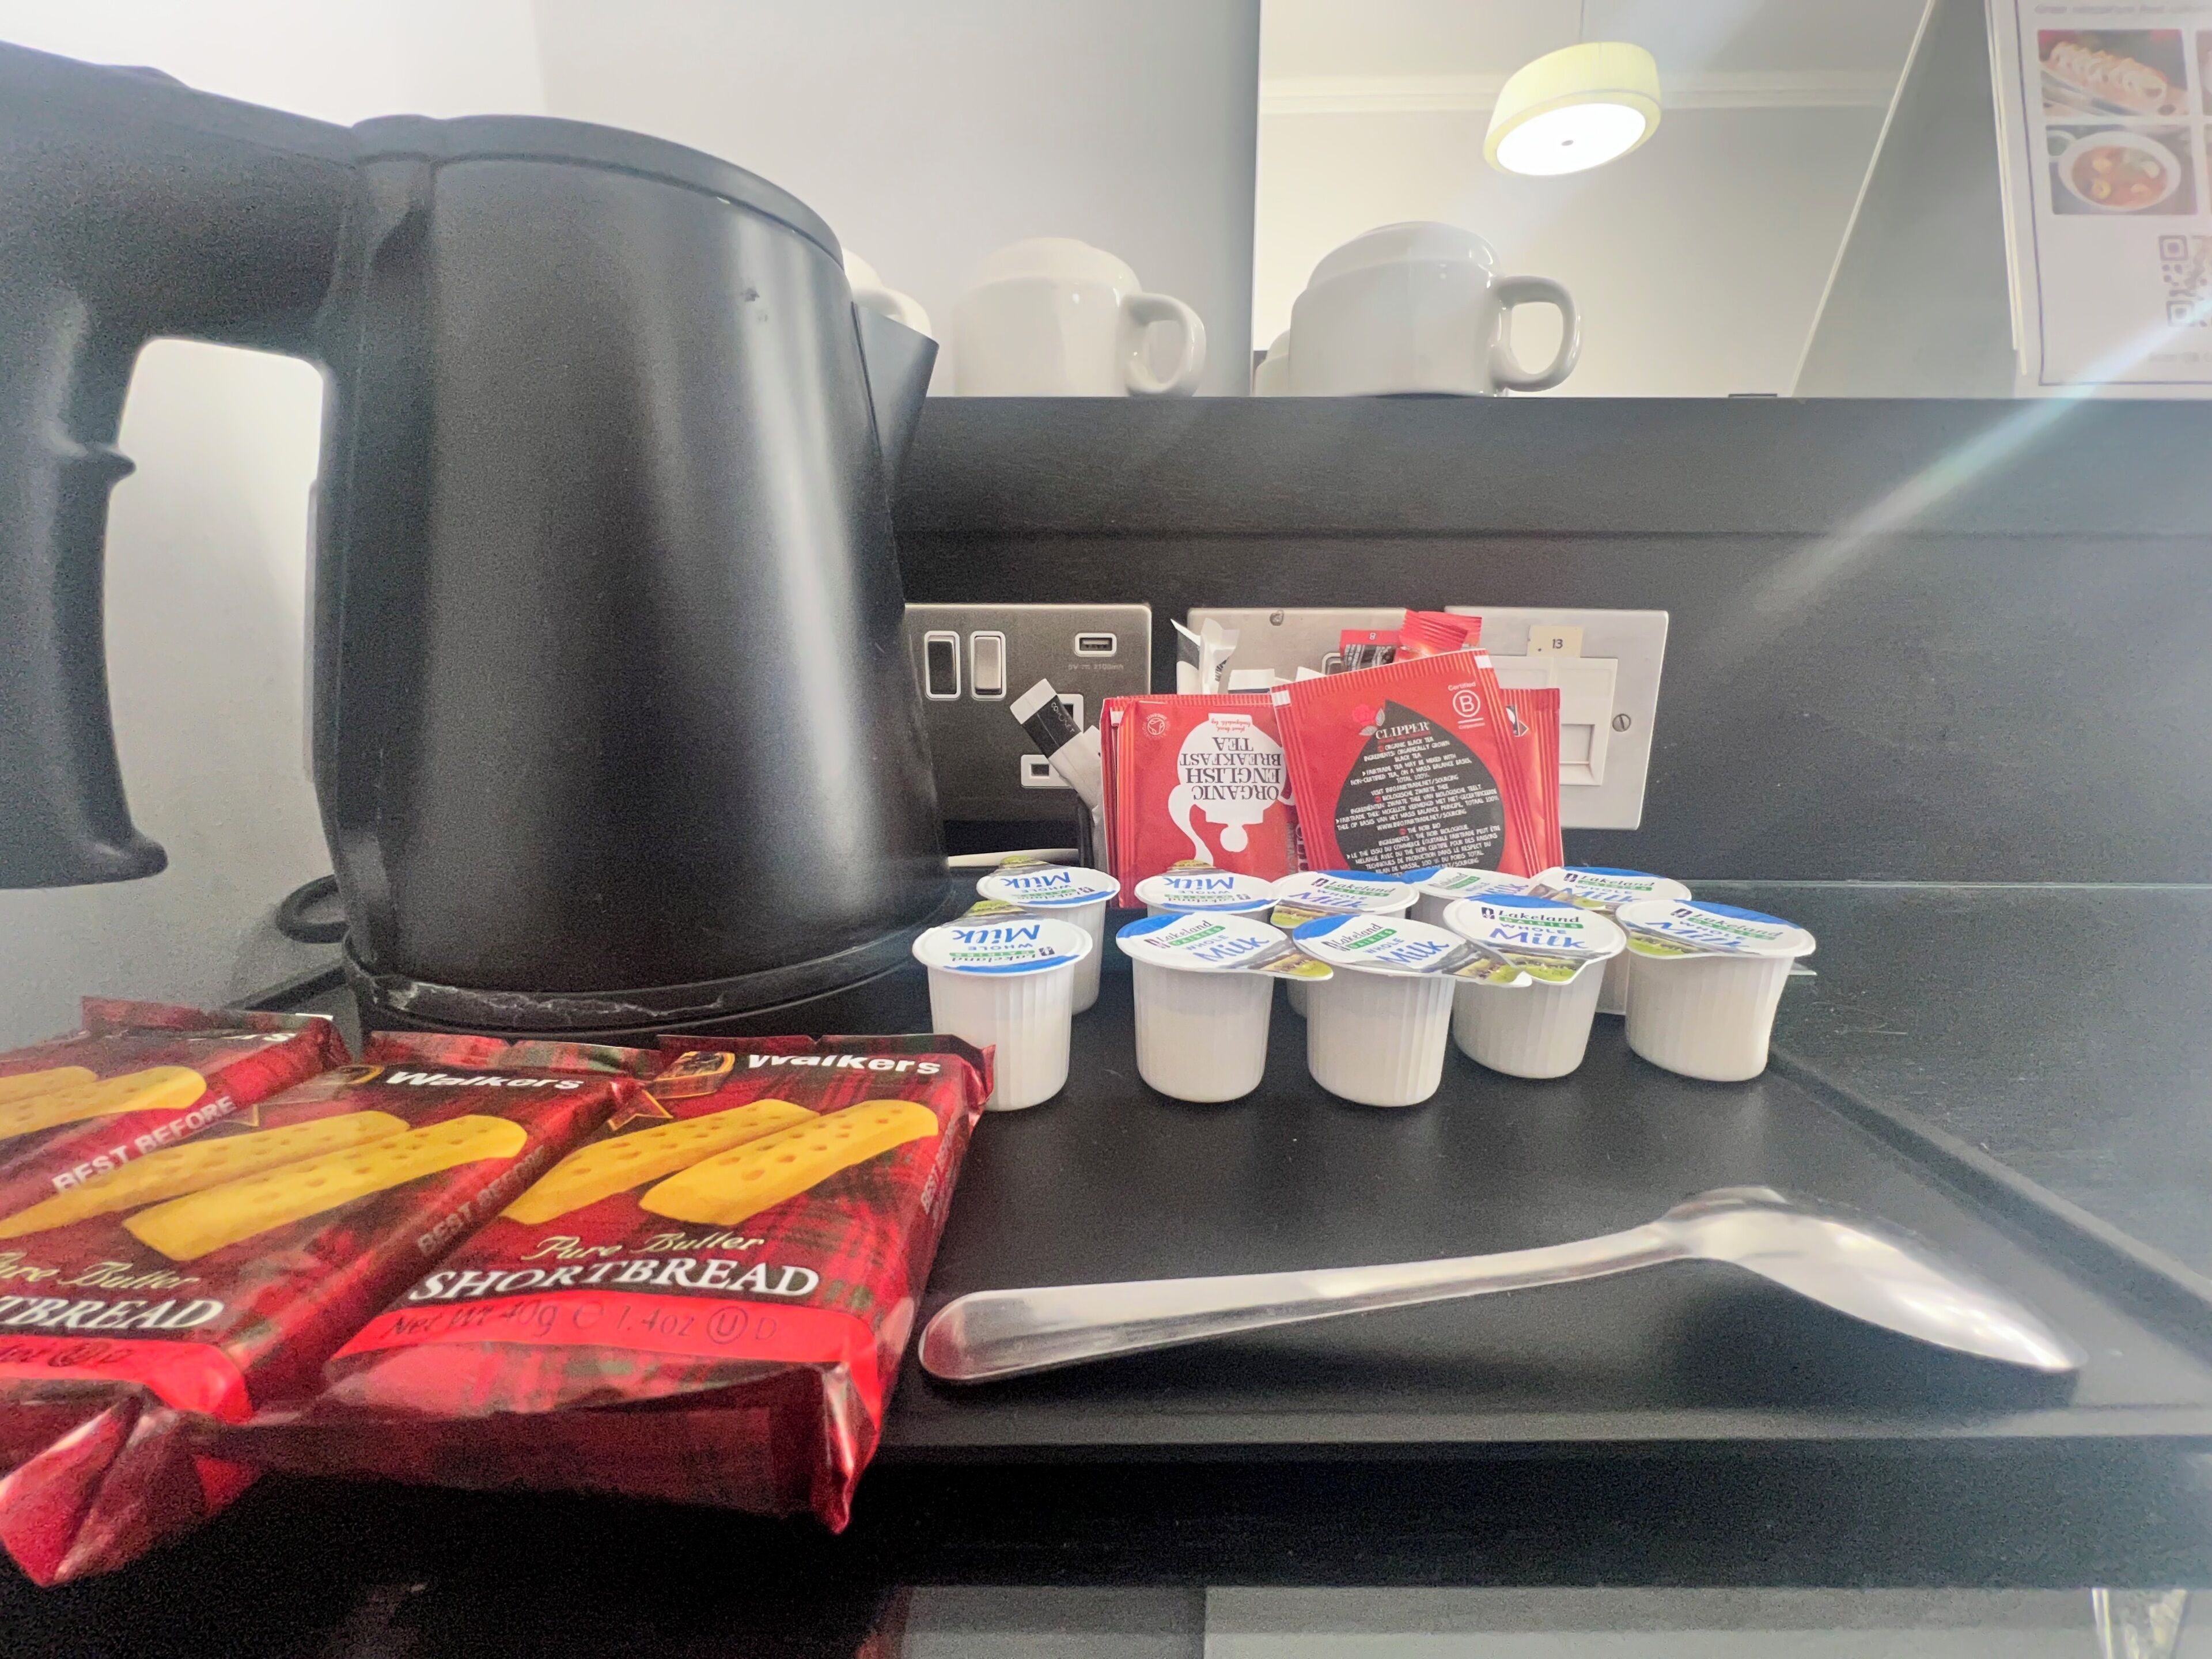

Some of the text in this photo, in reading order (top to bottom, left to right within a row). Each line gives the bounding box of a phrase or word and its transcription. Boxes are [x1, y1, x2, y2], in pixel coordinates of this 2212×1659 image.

[1552, 639, 1563, 649] 13
[1376, 721, 1430, 740] CLIPPER
[1211, 737, 1253, 752] TEA
[1179, 753, 1281, 766] BREAKFAST
[1185, 768, 1281, 784] ENGLISH
[1191, 785, 1279, 801] ORGANIC
[1000, 872, 1071, 888] Milk
[1163, 877, 1234, 889] Milk
[1330, 881, 1396, 893] Lakeland
[1581, 876, 1655, 887] Lakeland
[1317, 889, 1368, 900] WHOLE
[1575, 885, 1633, 894] WHOLE
[1289, 892, 1368, 908] Milk
[1498, 910, 1579, 922] Lakeland
[1504, 918, 1578, 929] DAIRIES
[951, 924, 1040, 944] Milk
[1157, 920, 1213, 942] Lakeland
[1333, 923, 1383, 946] Lakeland
[1500, 923, 1567, 934] WHOLE
[1645, 922, 1749, 948] Milk
[1182, 934, 1229, 950] WHOLE
[1364, 938, 1404, 954] WHOLE
[1489, 928, 1588, 948] Milk
[1193, 937, 1270, 961] Milk
[1376, 941, 1450, 963] Milk
[749, 1054, 942, 1075] Walkers
[386, 1071, 584, 1089] Walkers
[51, 1096, 237, 1194] BEST BEFORE
[418, 1201, 472, 1256] BEST
[521, 1231, 765, 1260] Pure Butter
[58, 1261, 201, 1290] Butter
[408, 1257, 820, 1301] SHORTBREAD
[395, 1312, 442, 1335] Net
[447, 1304, 494, 1330] Wt
[755, 1316, 778, 1341] D
